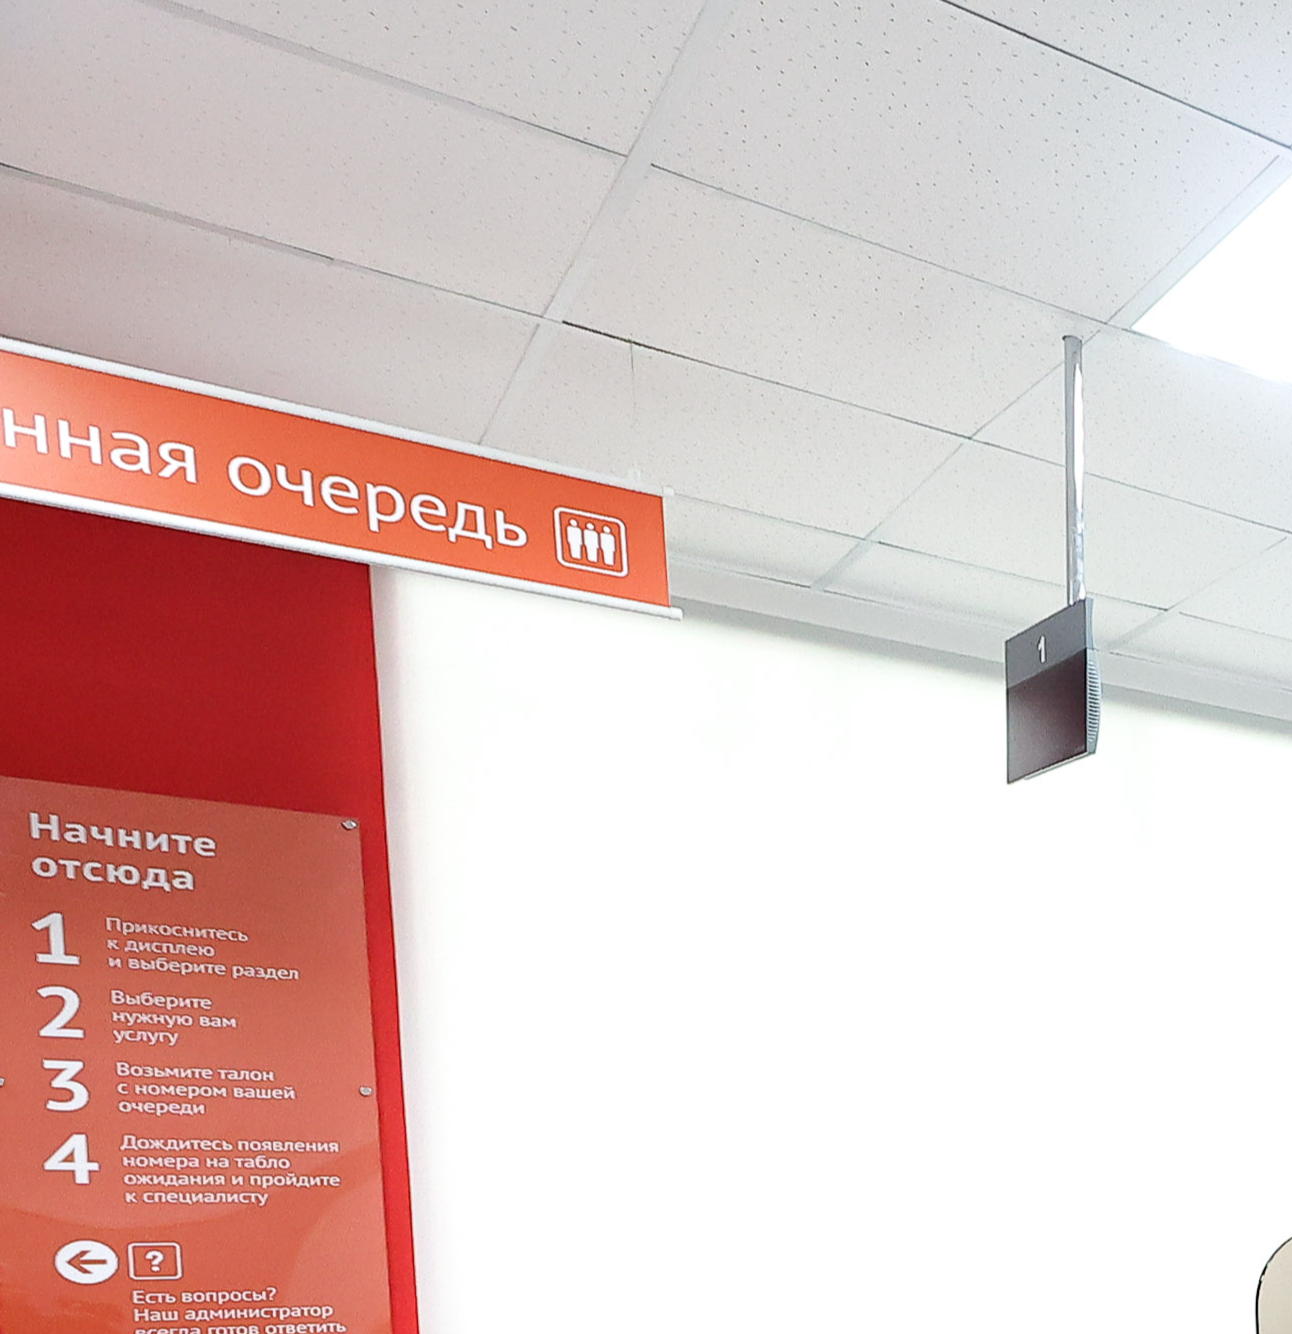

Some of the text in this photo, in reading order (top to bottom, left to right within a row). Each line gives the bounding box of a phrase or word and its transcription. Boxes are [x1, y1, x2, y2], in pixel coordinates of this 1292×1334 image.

[3, 407, 528, 549] нная очередь
[1037, 635, 1045, 663] 1
[29, 812, 217, 857] Начните
[31, 857, 195, 891] отсюда
[32, 912, 80, 965] 1
[106, 917, 249, 942] Прикоснитесь
[108, 939, 215, 957] к дисплею
[108, 958, 299, 980] и выберите раздел
[111, 990, 212, 1009] Выберите
[37, 986, 85, 1038] 2
[112, 1011, 237, 1028] нужную вам
[113, 1029, 178, 1046] услугу
[116, 1062, 274, 1081] Возьмите талон
[42, 1059, 90, 1112] 3
[118, 1083, 296, 1099] с номером вашей
[118, 1101, 205, 1115] очереди
[120, 1135, 339, 1152] Дождитесь появления
[42, 1133, 100, 1184] 4
[122, 1156, 291, 1171] номера на табло
[124, 1172, 340, 1188] ожидания и пройдите
[125, 1191, 269, 1206] к специалисту
[132, 1287, 277, 1304] Есть вопросы?
[133, 1305, 334, 1322] Наш администратор
